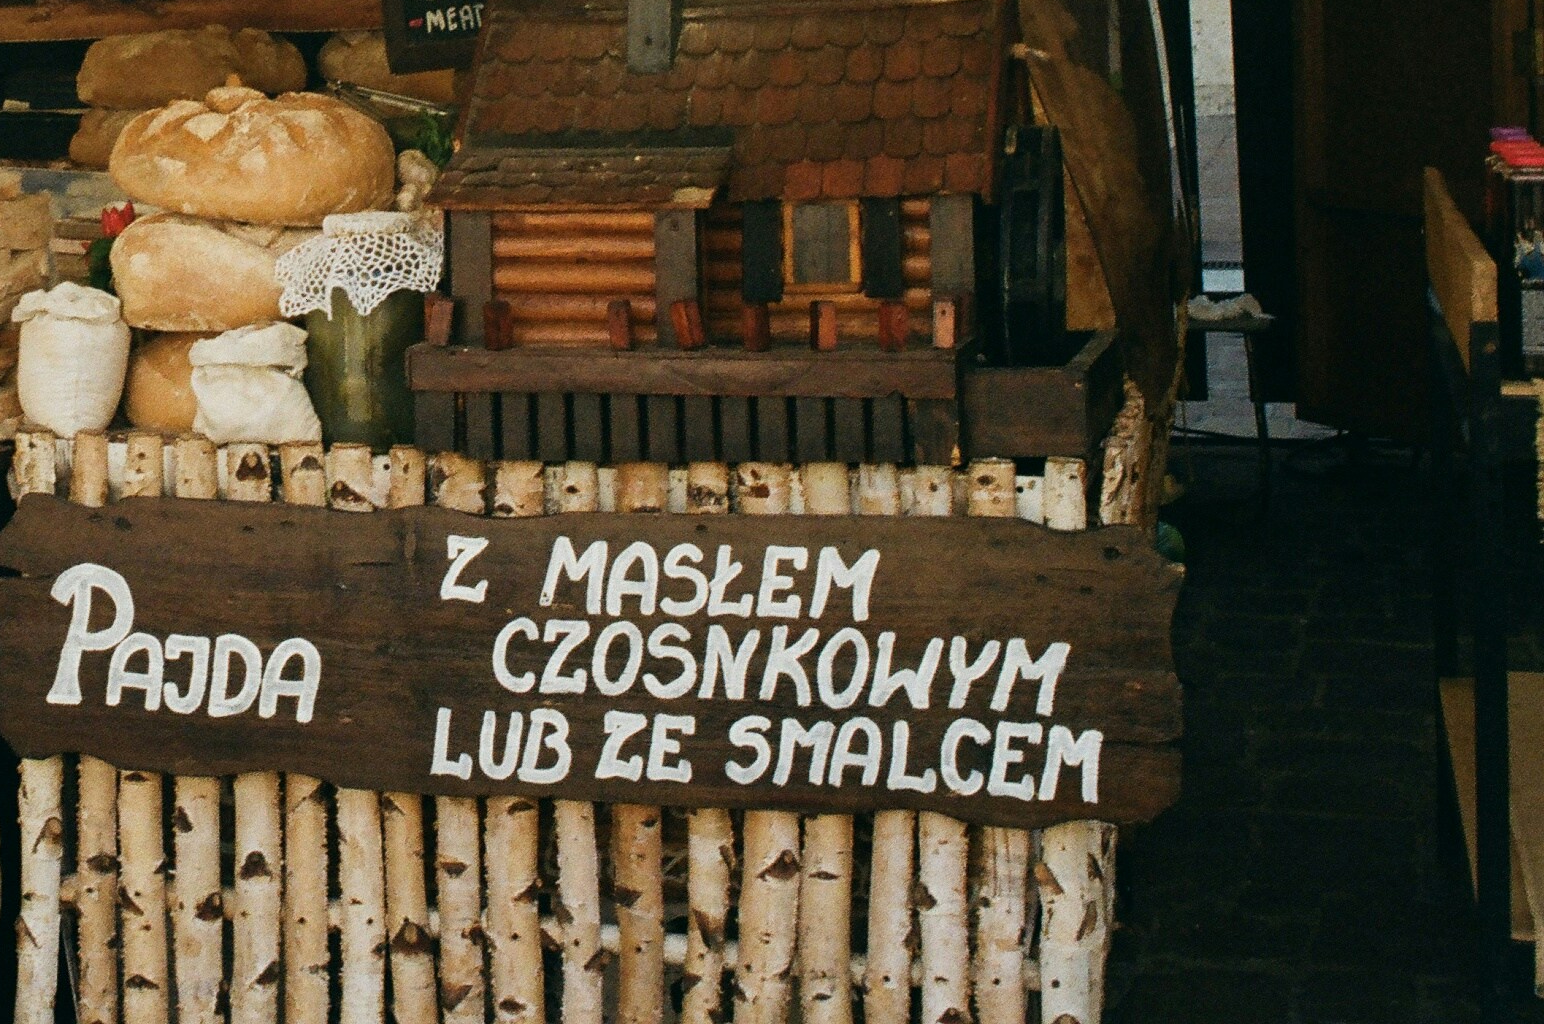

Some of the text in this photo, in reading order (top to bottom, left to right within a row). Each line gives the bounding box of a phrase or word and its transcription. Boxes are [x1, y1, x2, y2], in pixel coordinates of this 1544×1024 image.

[426, 3, 484, 33] MEAT
[440, 534, 881, 622] Z MASŁEM
[492, 616, 1072, 717] CZOSNKOWYM
[429, 707, 1104, 804] LUB ZE SMALCEM
